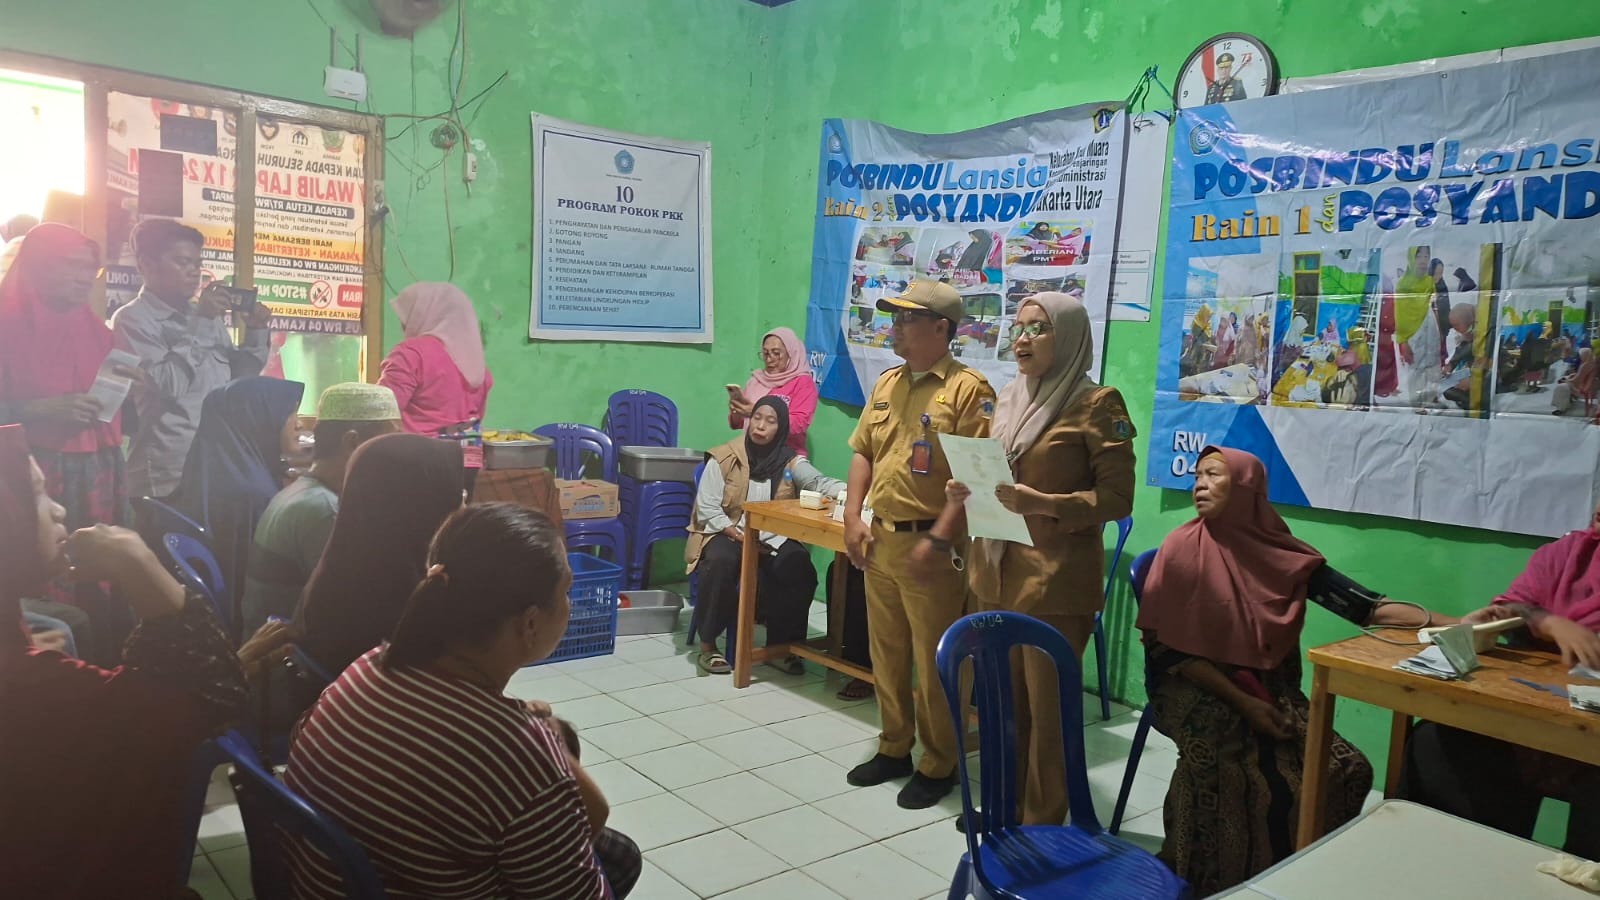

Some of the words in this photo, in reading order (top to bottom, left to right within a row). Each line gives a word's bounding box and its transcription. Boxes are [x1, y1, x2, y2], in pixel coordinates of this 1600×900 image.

[1223, 42, 1232, 50] 12
[1183, 90, 1188, 98] 9
[826, 160, 944, 190] POSBINDU
[942, 158, 1048, 190] Lansia
[1194, 142, 1434, 200] POSBINDU
[616, 186, 634, 204] 10
[894, 190, 1044, 222] POSYANDU
[1075, 185, 1103, 211] Utara
[557, 198, 616, 214] PROGRAM
[620, 206, 659, 218] POKOK
[662, 210, 684, 220] PKK
[872, 202, 884, 222] 2
[1314, 193, 1338, 234] dan
[556, 228, 582, 237] GOTONG
[584, 232, 608, 240] ROYONG
[1189, 210, 1280, 243] Rain
[1294, 205, 1312, 236] 1
[556, 238, 582, 246] PANGAN
[1172, 430, 1207, 454] RW
